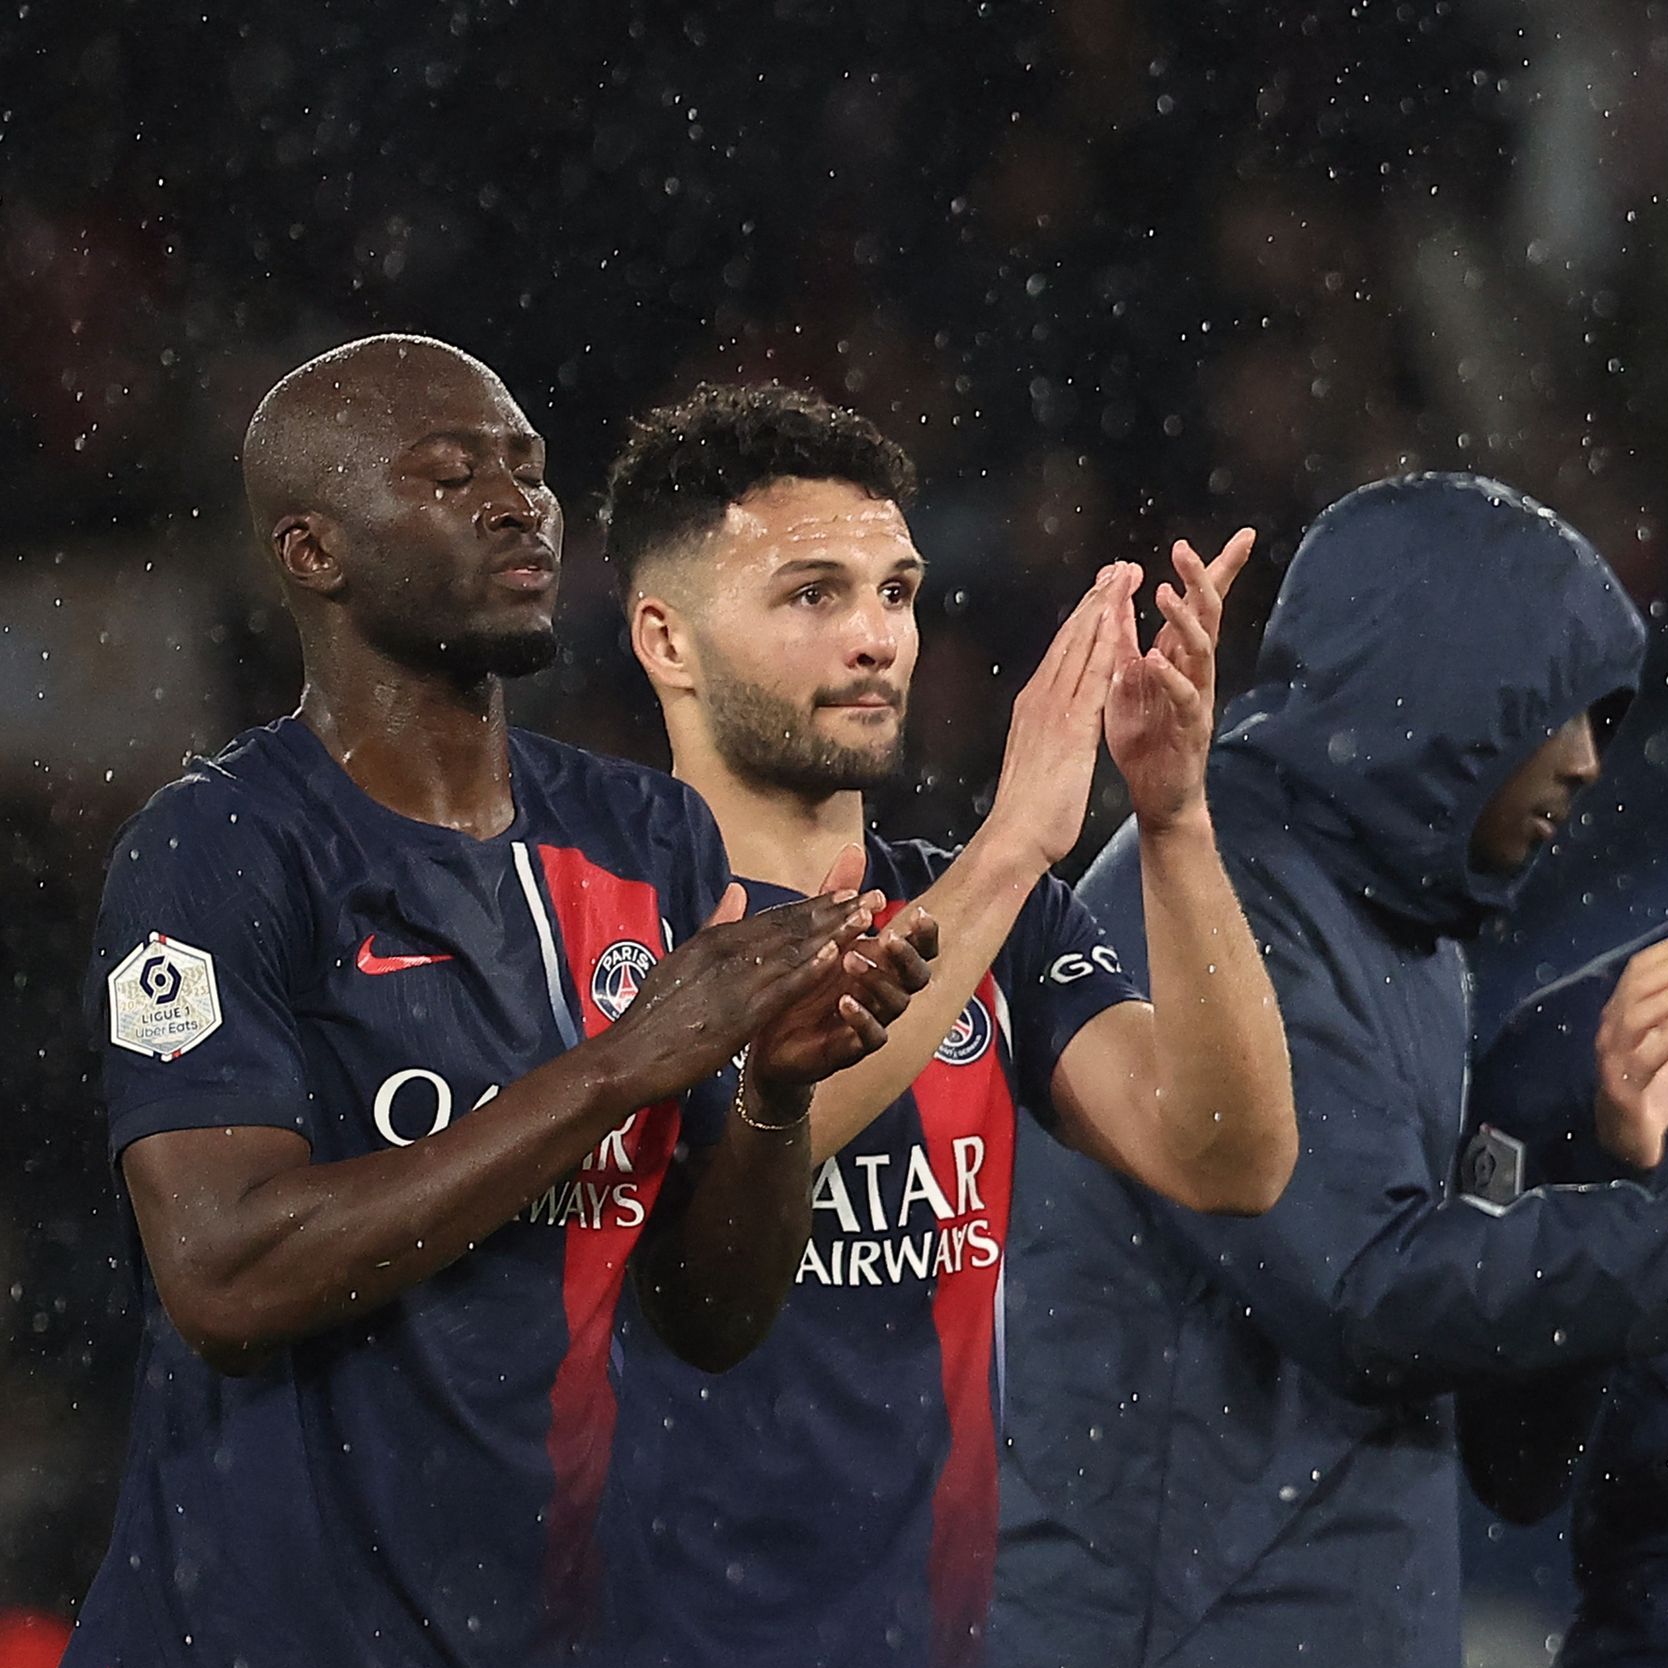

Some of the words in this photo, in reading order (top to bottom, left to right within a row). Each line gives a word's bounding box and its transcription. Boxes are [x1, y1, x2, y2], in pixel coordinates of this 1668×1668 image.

[602, 946, 650, 972] PARIS
[142, 1007, 181, 1024] LIGUE
[185, 1006, 191, 1016] 1
[168, 1020, 198, 1034] Eats
[812, 1135, 985, 1233] ATAR
[512, 1180, 645, 1230] WAYS
[795, 1219, 999, 1287] AIRWAYS
